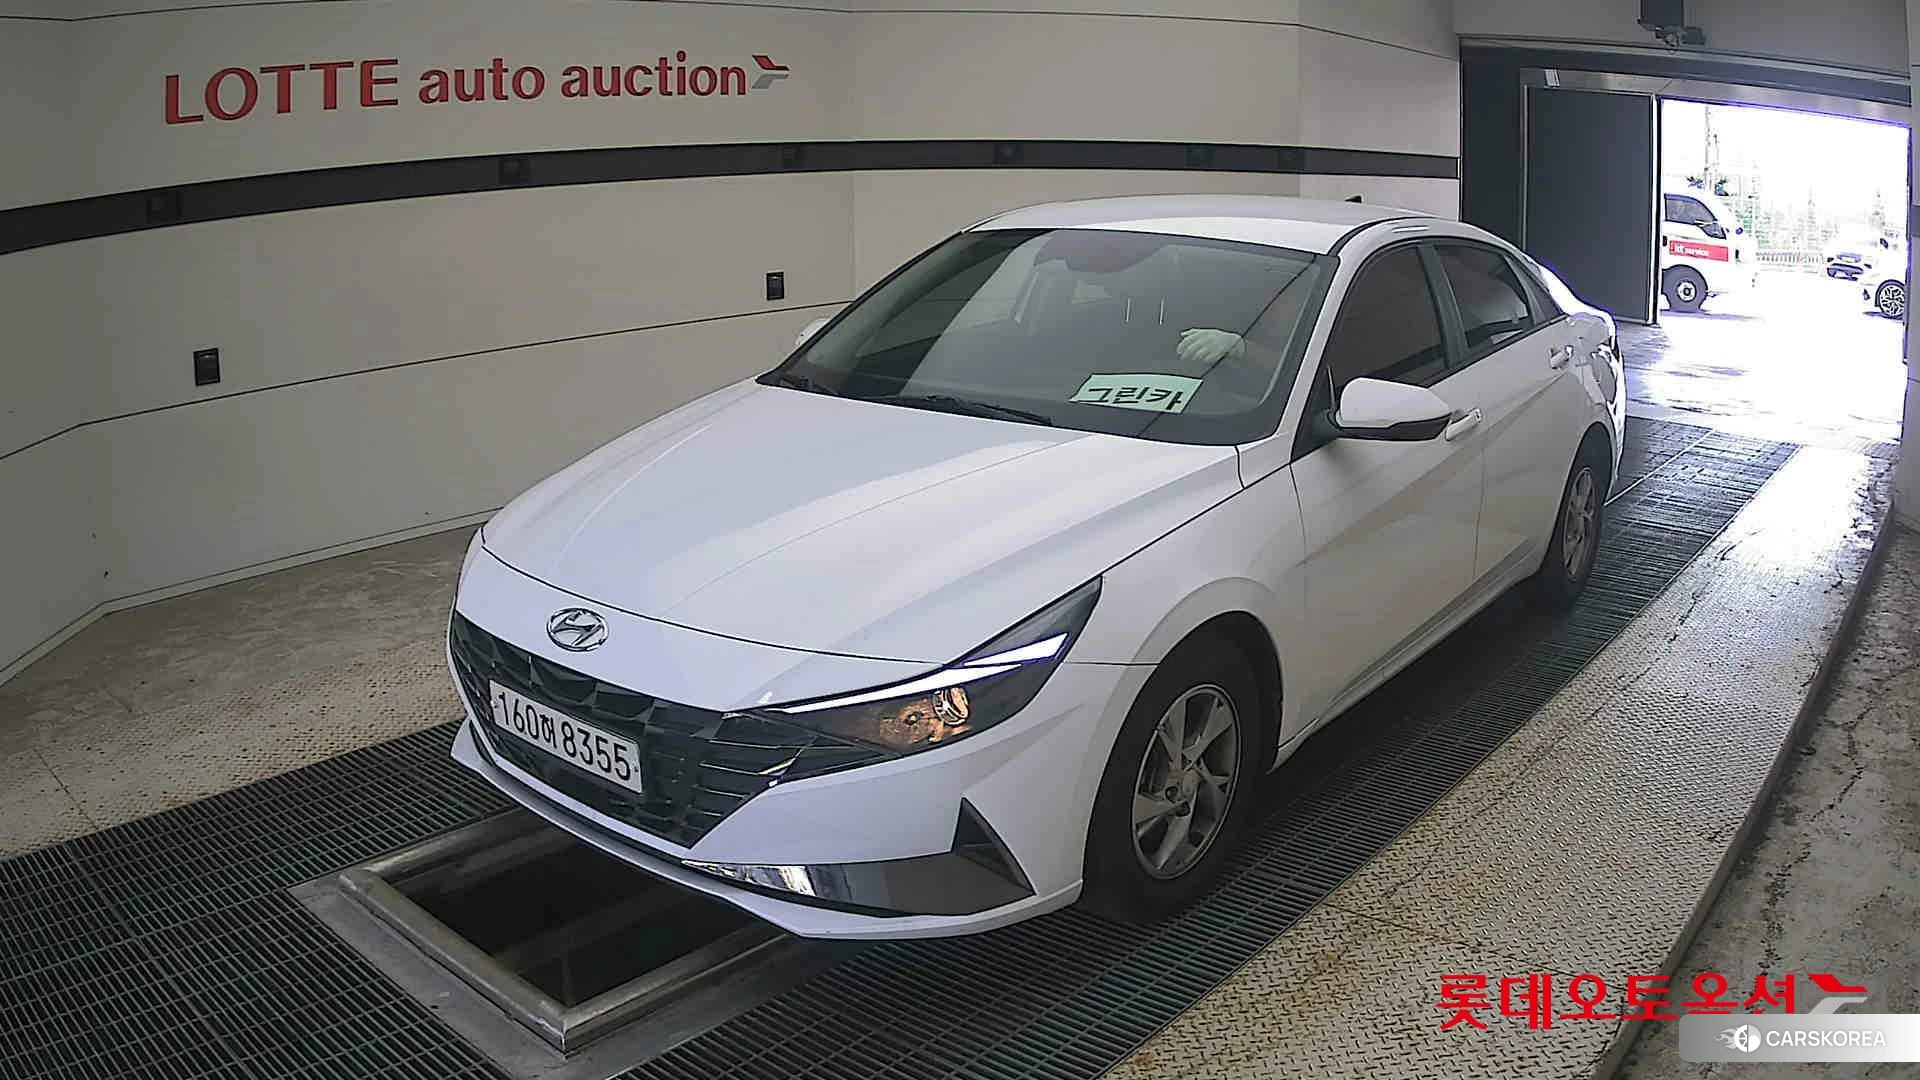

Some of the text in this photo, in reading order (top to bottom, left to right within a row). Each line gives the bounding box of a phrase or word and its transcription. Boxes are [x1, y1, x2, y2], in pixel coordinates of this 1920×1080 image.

[165, 51, 748, 125] LOTTE auto auction
[1077, 386, 1184, 411] 그린카
